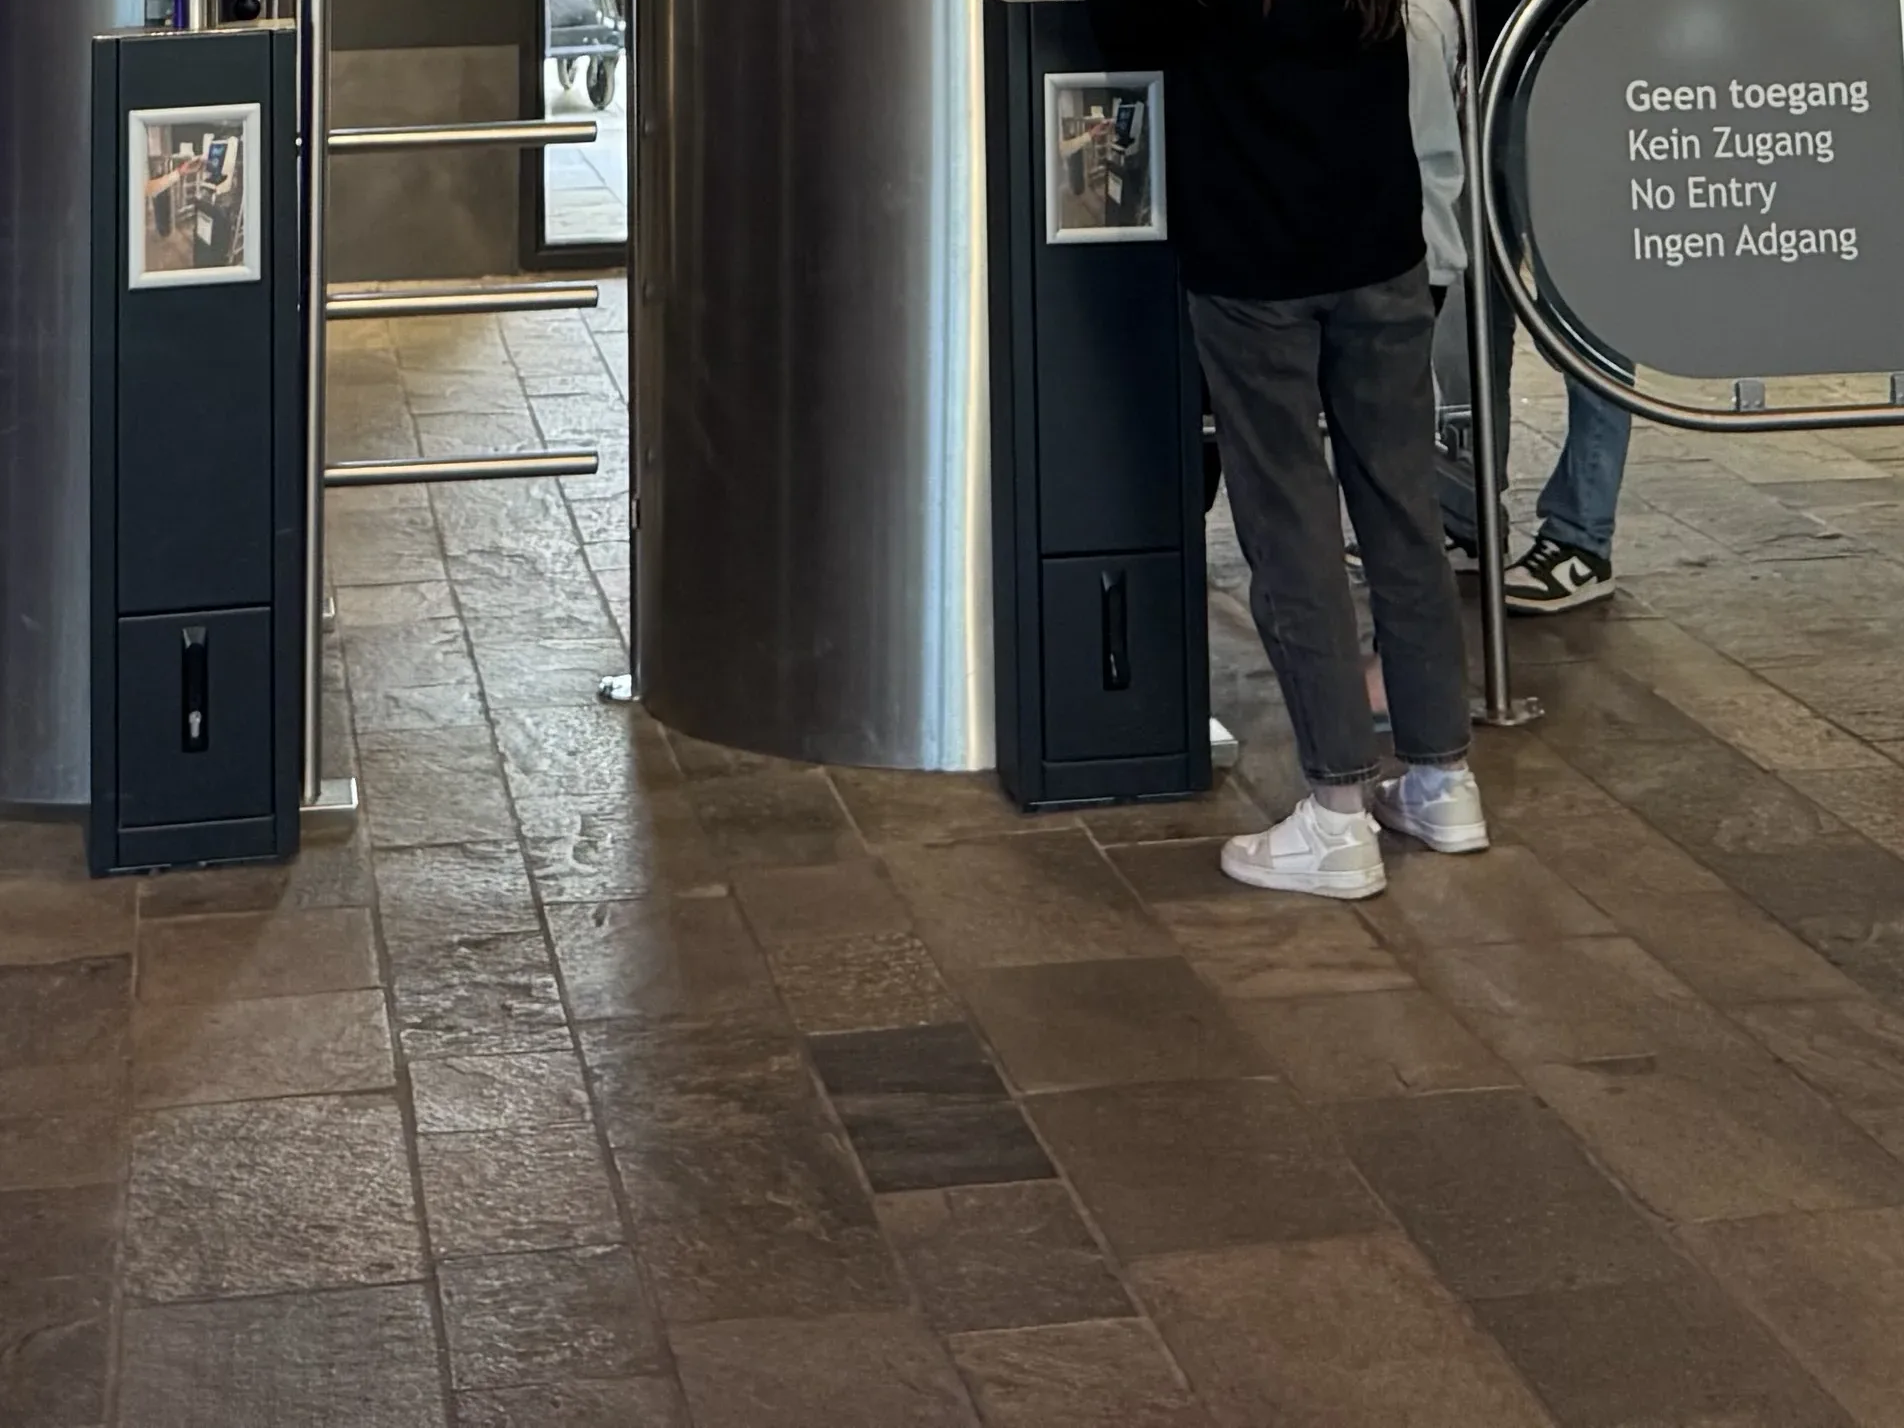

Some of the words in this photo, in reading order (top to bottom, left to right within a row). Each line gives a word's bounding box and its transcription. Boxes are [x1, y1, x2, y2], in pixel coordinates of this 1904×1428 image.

[1625, 80, 1716, 112] Geen
[1729, 79, 1869, 113] toegang
[1629, 129, 1701, 161] Kein
[1713, 127, 1834, 165] Zugang
[1631, 178, 1675, 211] No
[1688, 176, 1777, 214] Entry
[1634, 228, 1725, 266] Ingen
[1735, 223, 1859, 261] Adgang
